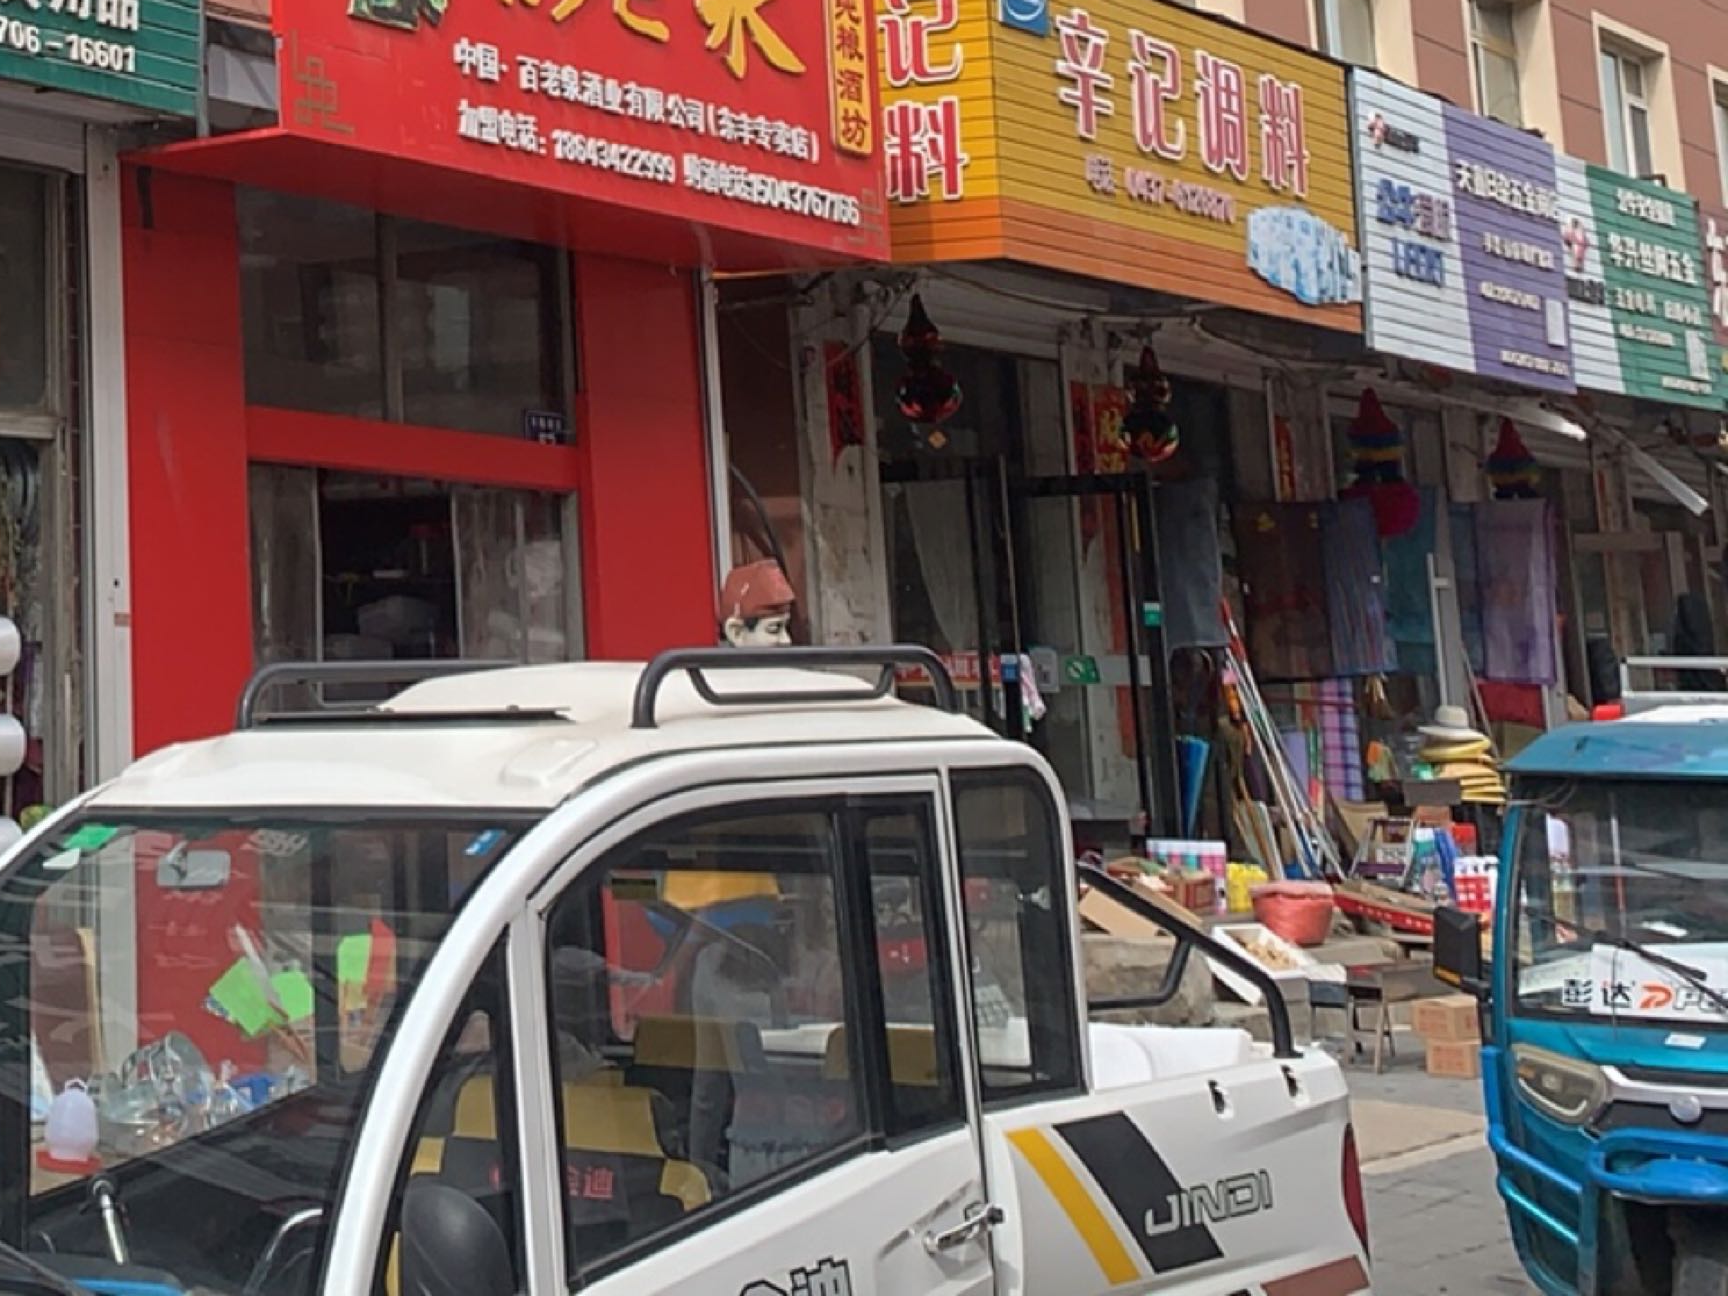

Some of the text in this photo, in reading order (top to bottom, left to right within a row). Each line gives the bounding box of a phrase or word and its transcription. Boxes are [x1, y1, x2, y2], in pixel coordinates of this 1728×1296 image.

[883, 95, 971, 203] 料
[1055, 8, 1311, 200] 辛记调料
[1145, 1168, 1274, 1237] JINDI
